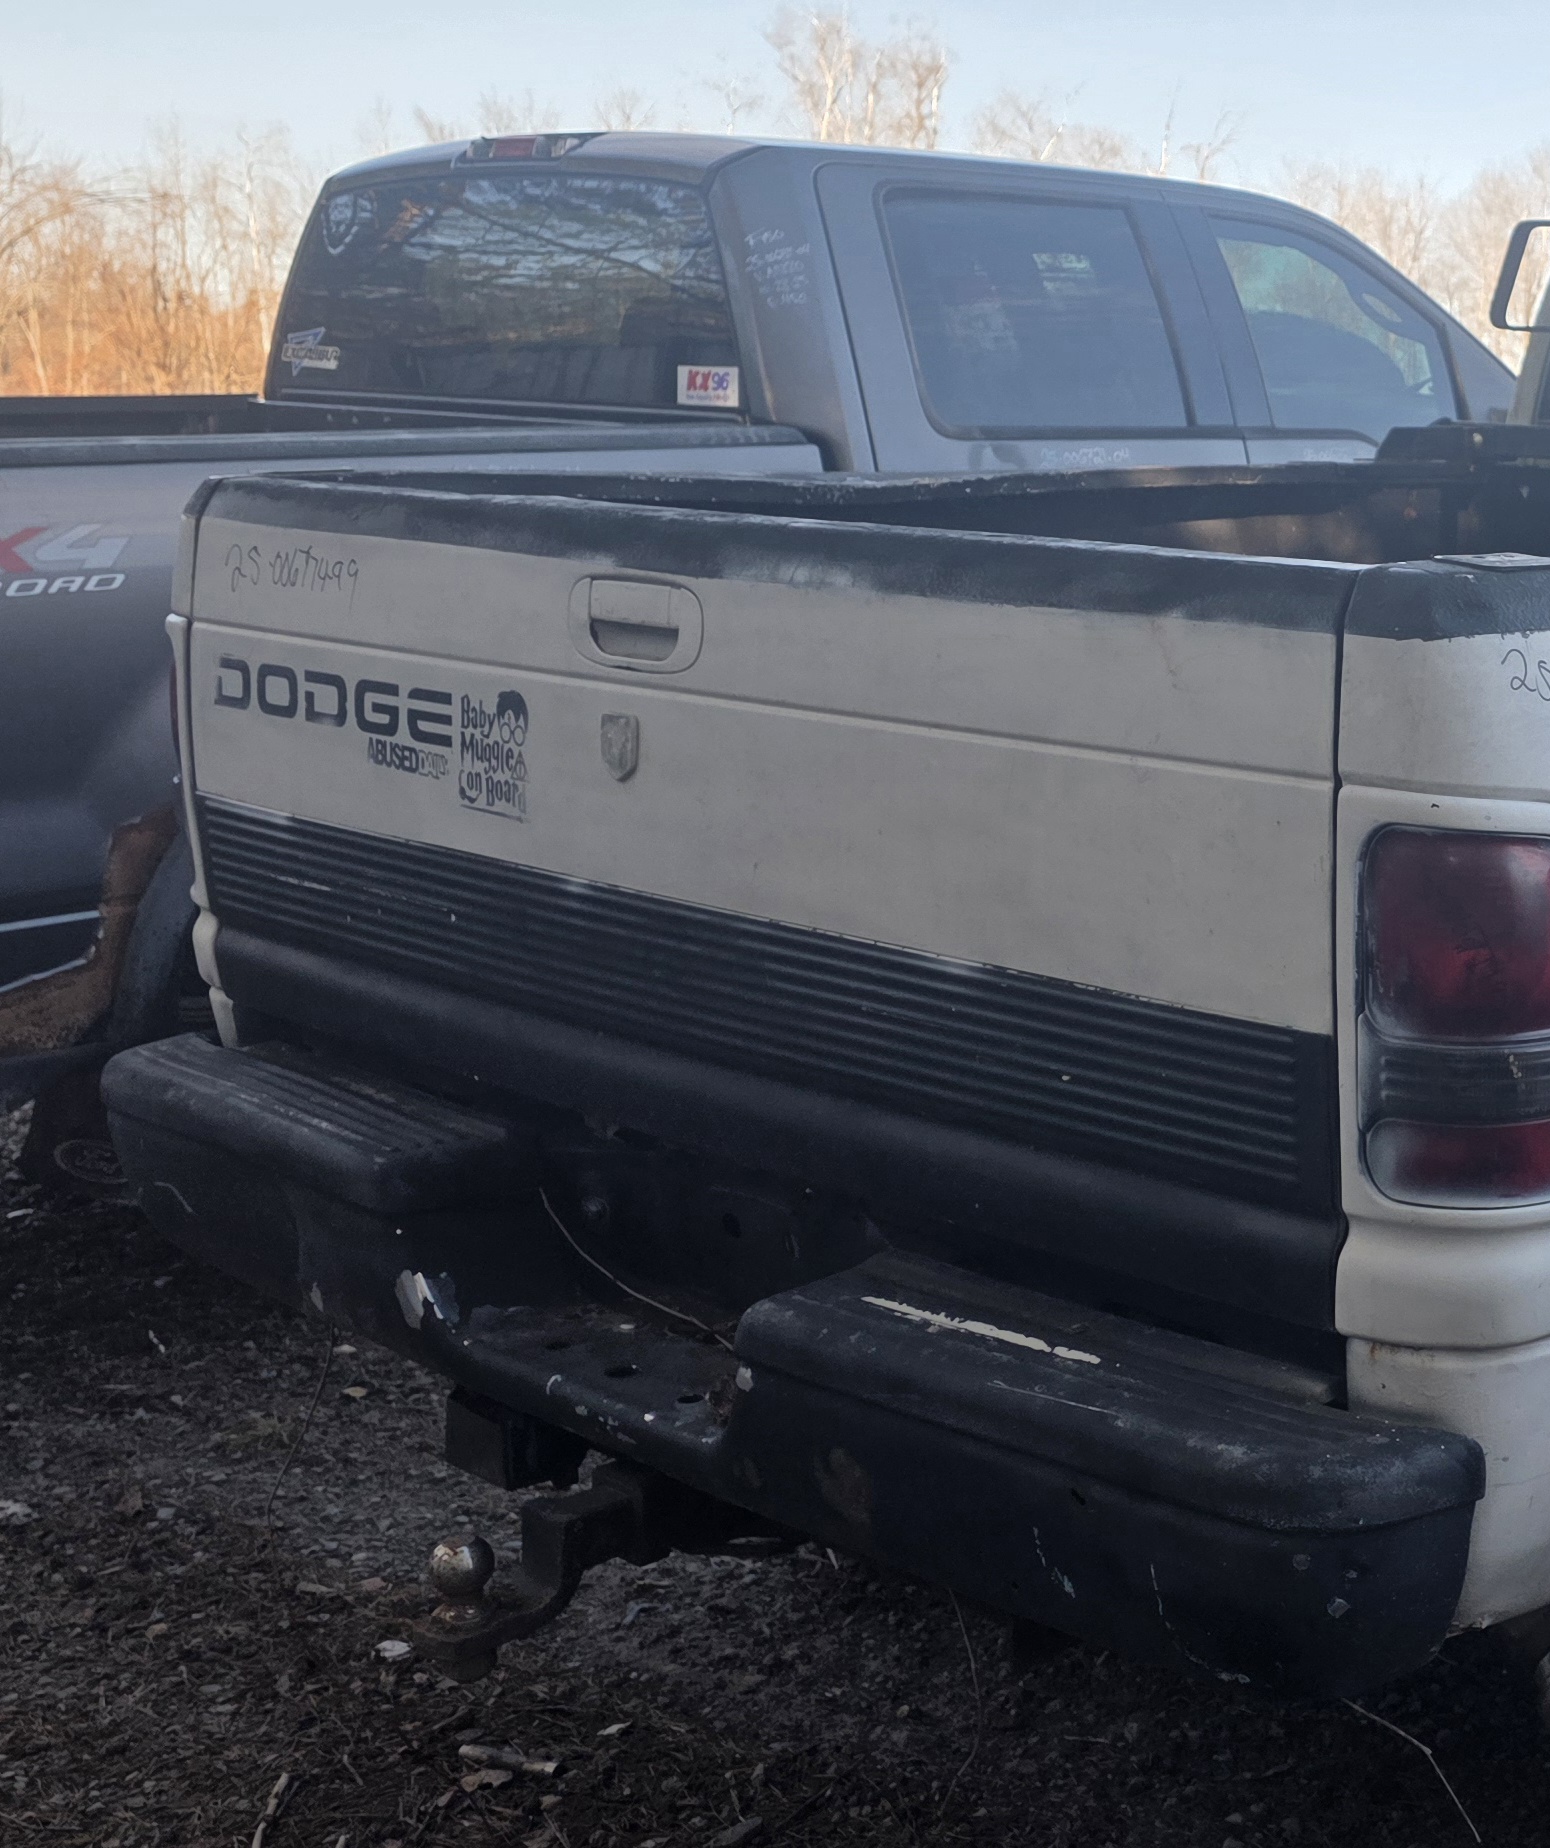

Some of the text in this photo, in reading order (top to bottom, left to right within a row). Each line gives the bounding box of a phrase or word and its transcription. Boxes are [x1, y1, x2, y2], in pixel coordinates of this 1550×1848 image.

[0, 573, 125, 597] OAD
[213, 656, 453, 748] DODGE
[460, 694, 496, 739] Baby
[460, 731, 514, 775] Muggle
[466, 770, 527, 815] on Board
